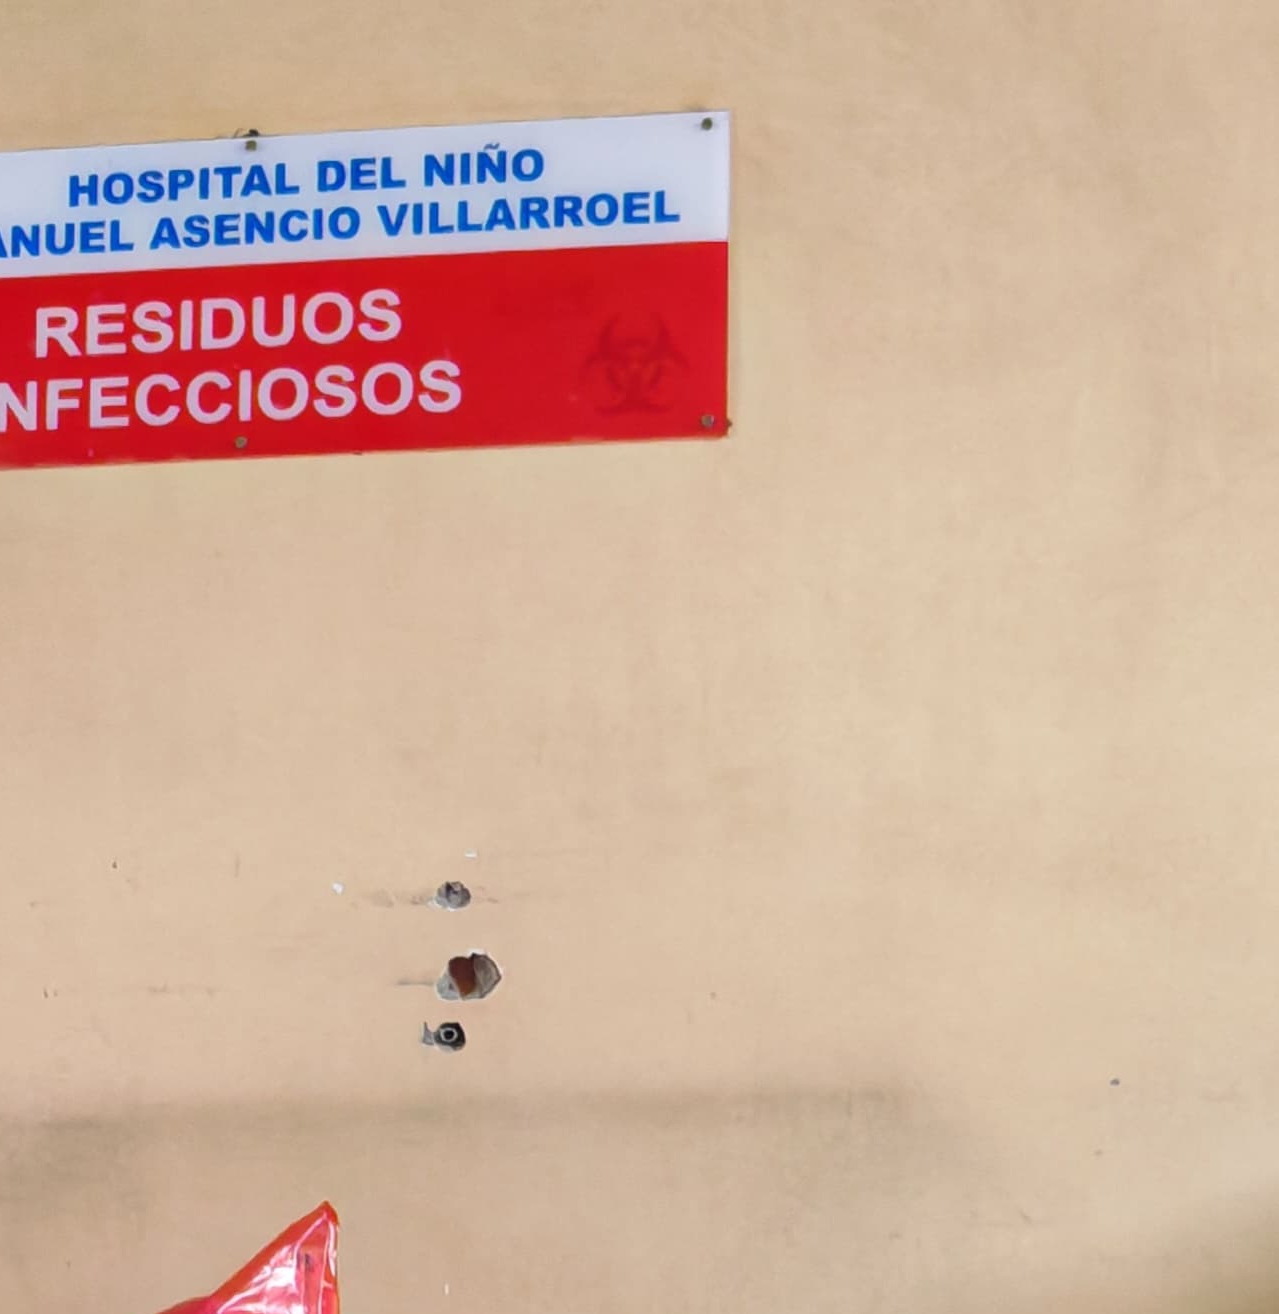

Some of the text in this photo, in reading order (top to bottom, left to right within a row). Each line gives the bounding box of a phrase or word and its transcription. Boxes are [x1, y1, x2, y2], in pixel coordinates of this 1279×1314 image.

[67, 141, 545, 208] HOSPITAL DEL NIÑO
[149, 209, 361, 251] ASENCIO
[376, 190, 681, 238] VILLARROEL
[34, 288, 403, 359] RESIDUOS
